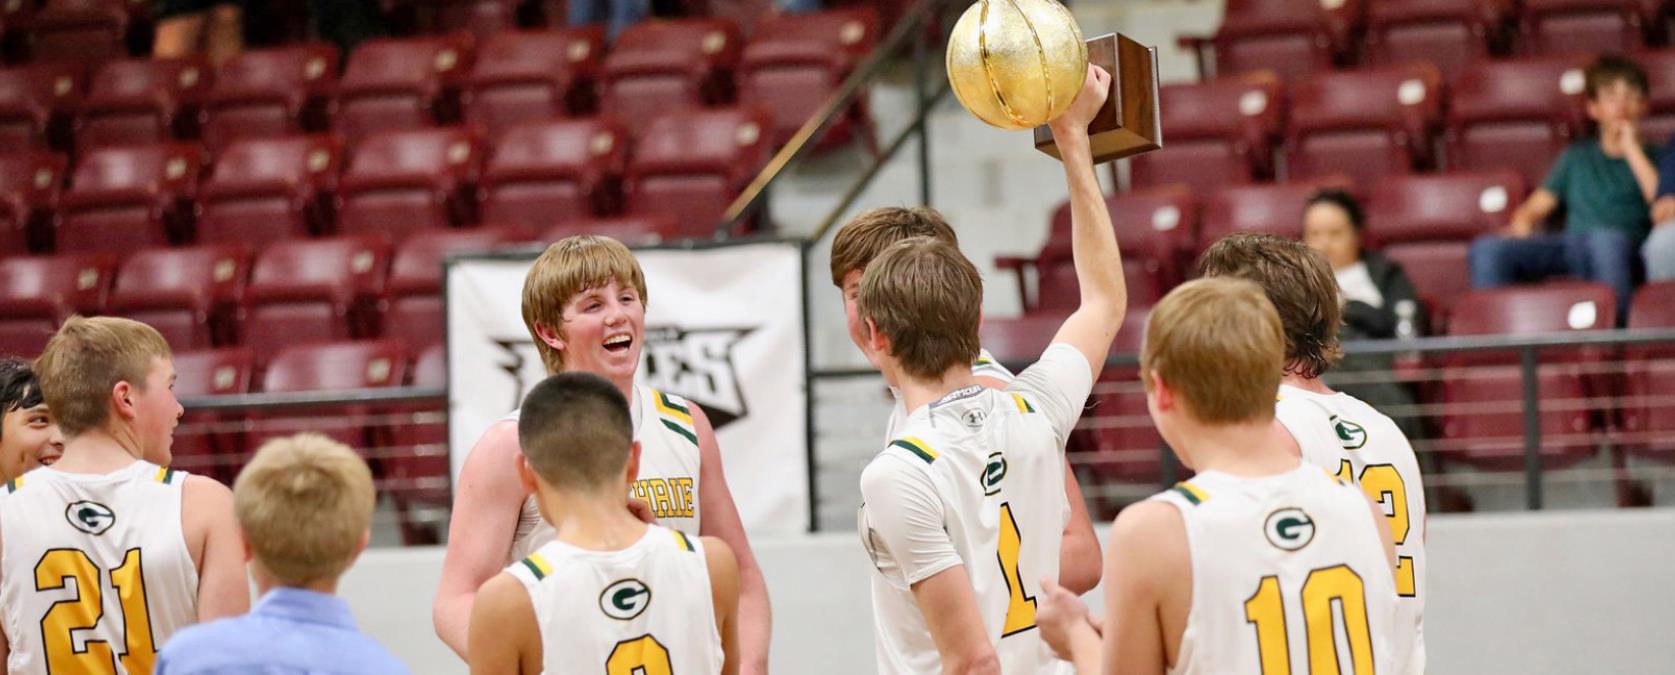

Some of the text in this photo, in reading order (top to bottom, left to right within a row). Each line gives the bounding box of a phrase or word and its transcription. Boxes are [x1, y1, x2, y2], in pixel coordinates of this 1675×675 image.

[633, 477, 695, 519] HRIE
[1264, 507, 1316, 552] G
[1335, 459, 1416, 597] 2
[33, 547, 159, 675] 21
[599, 578, 652, 621] G
[996, 502, 1038, 639] 1
[1244, 563, 1376, 675] 10
